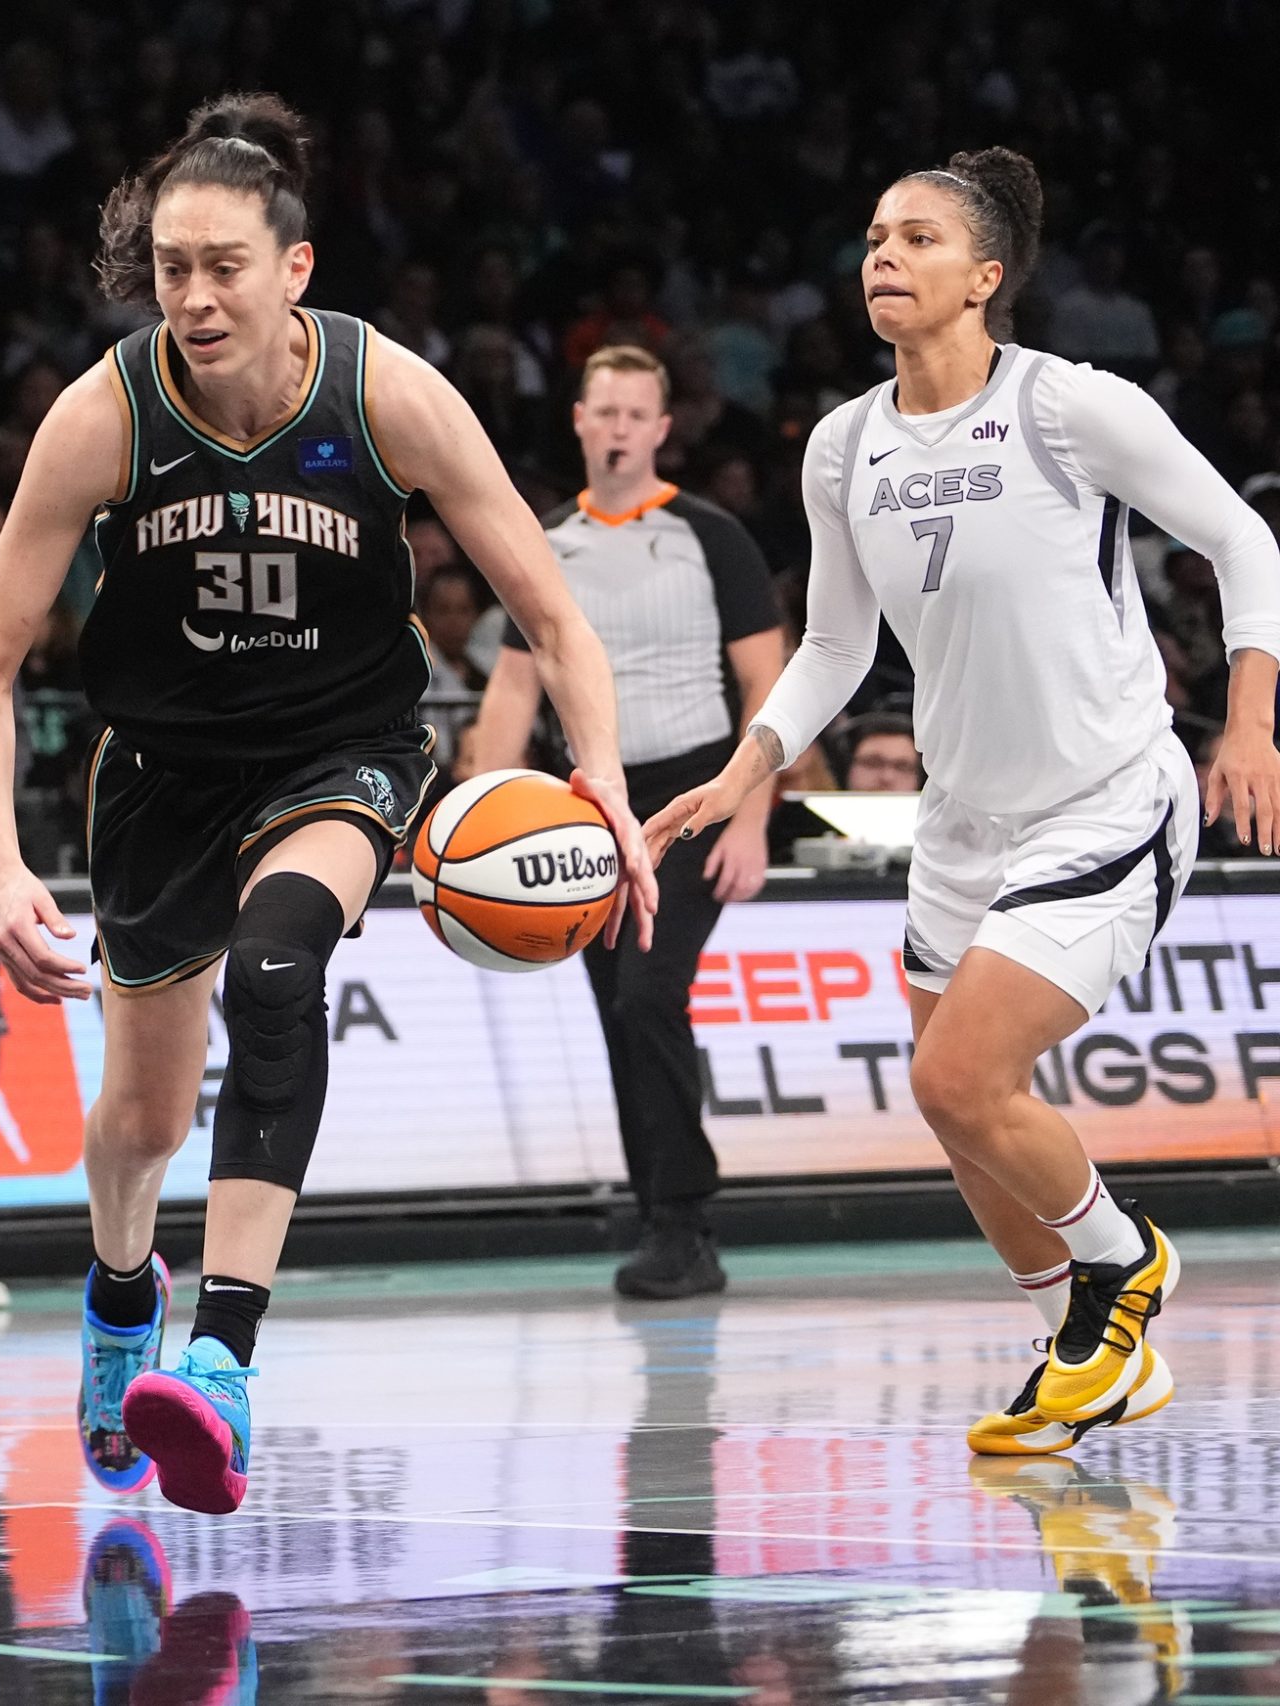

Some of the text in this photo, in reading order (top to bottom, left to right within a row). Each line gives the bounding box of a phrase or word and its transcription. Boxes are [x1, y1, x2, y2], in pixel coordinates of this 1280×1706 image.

[304, 459, 348, 469] BARCLAYS
[972, 420, 1009, 442] ally
[868, 464, 1003, 516] ACES
[135, 491, 360, 559] NEW YORK
[910, 515, 954, 592] 7
[194, 551, 298, 621] 30
[511, 847, 617, 889] Wilson
[686, 951, 873, 1025] EEP
[696, 1044, 826, 1116] LL
